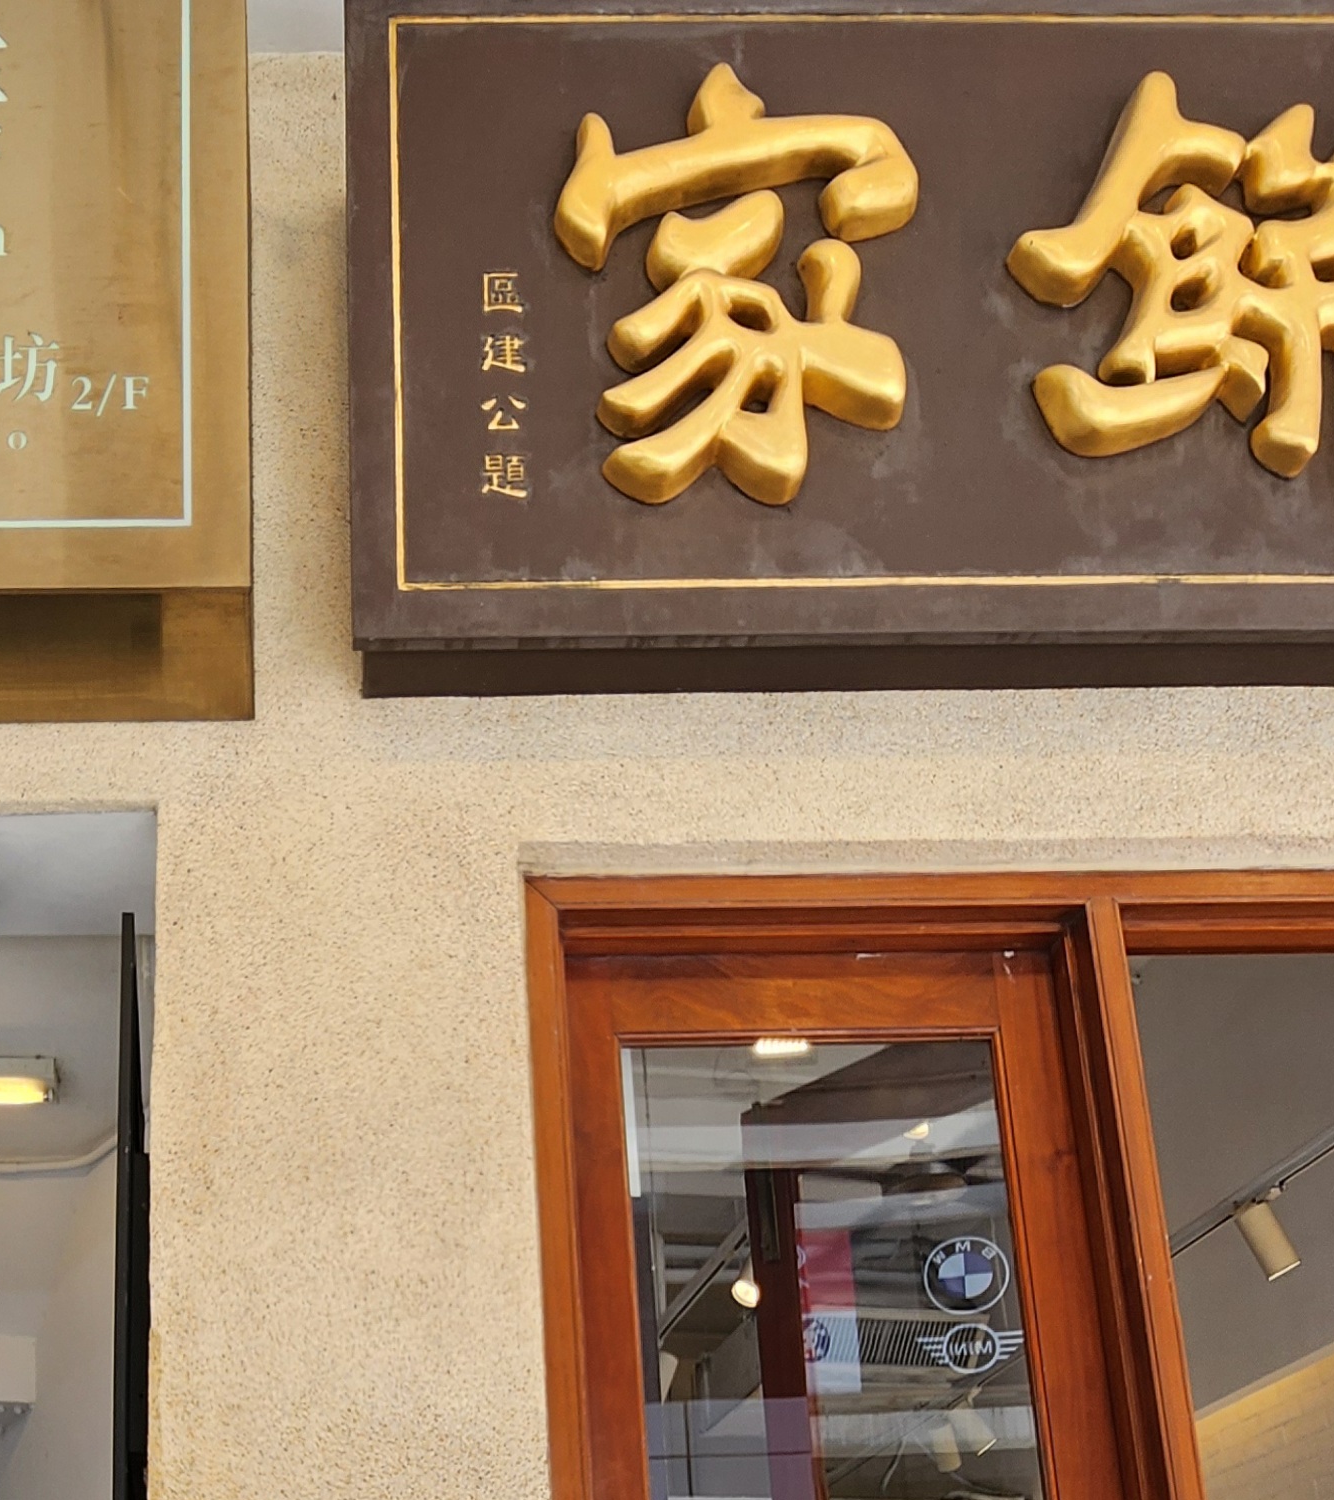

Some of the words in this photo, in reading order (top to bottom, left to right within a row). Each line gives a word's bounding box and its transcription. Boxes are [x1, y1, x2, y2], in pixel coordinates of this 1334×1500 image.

[70, 373, 151, 417] 2/F
[479, 268, 529, 500] 區建公題
